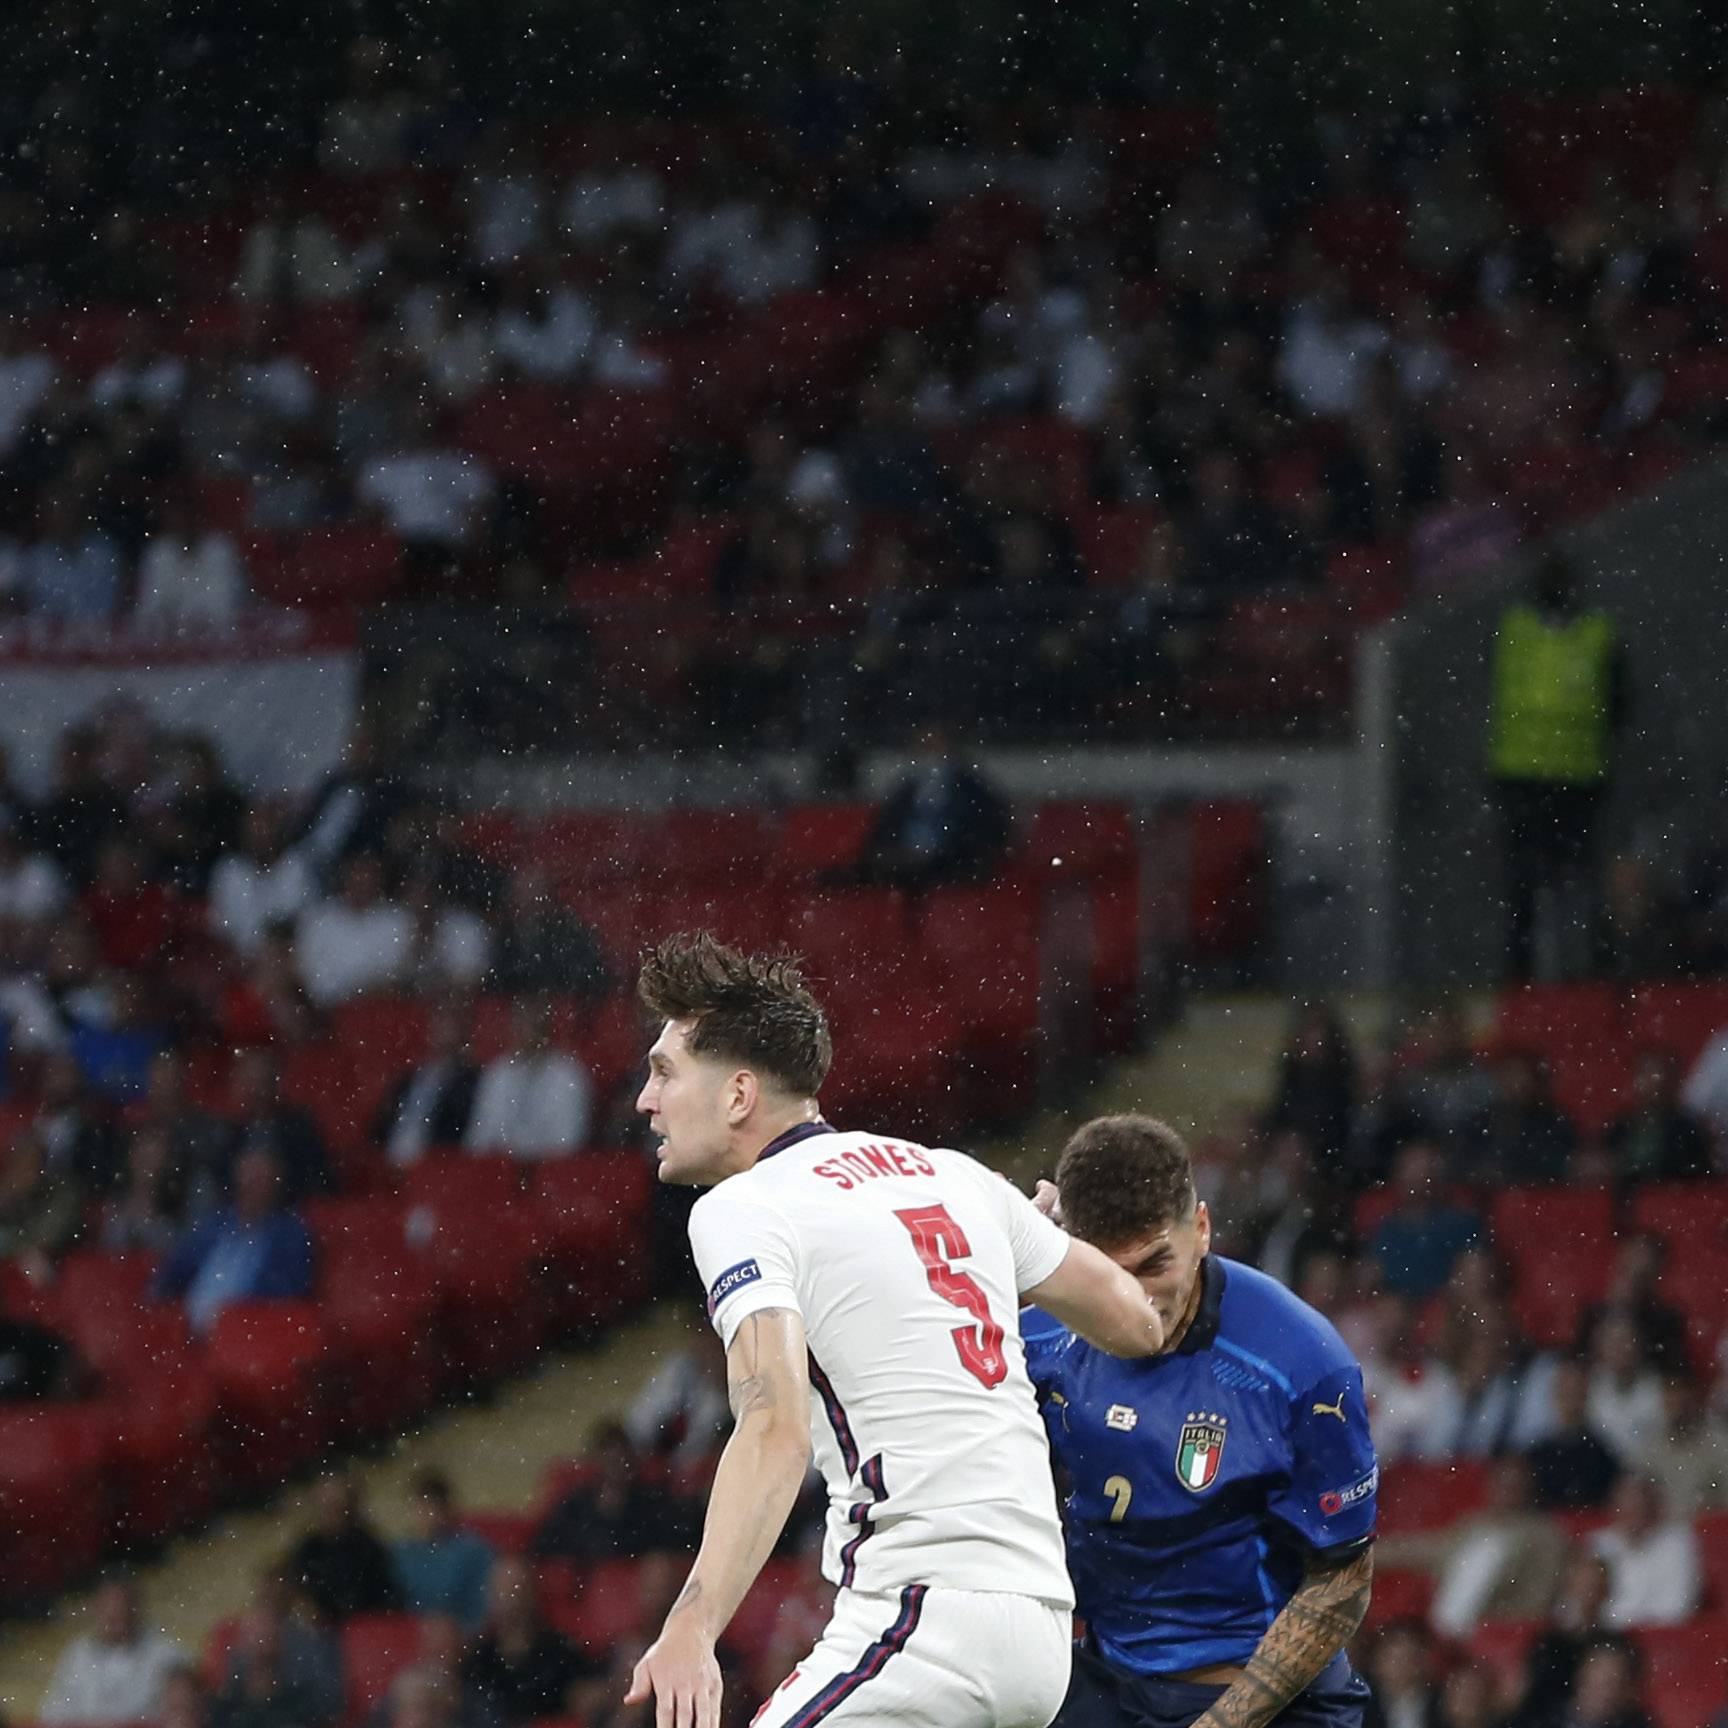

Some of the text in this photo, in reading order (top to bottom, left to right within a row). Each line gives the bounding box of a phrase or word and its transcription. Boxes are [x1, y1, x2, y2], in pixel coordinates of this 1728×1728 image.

[812, 1143, 936, 1190] STONES
[713, 1264, 757, 1301] RESPECT
[892, 1203, 1008, 1390] 5
[1185, 1429, 1222, 1443] ITALIA
